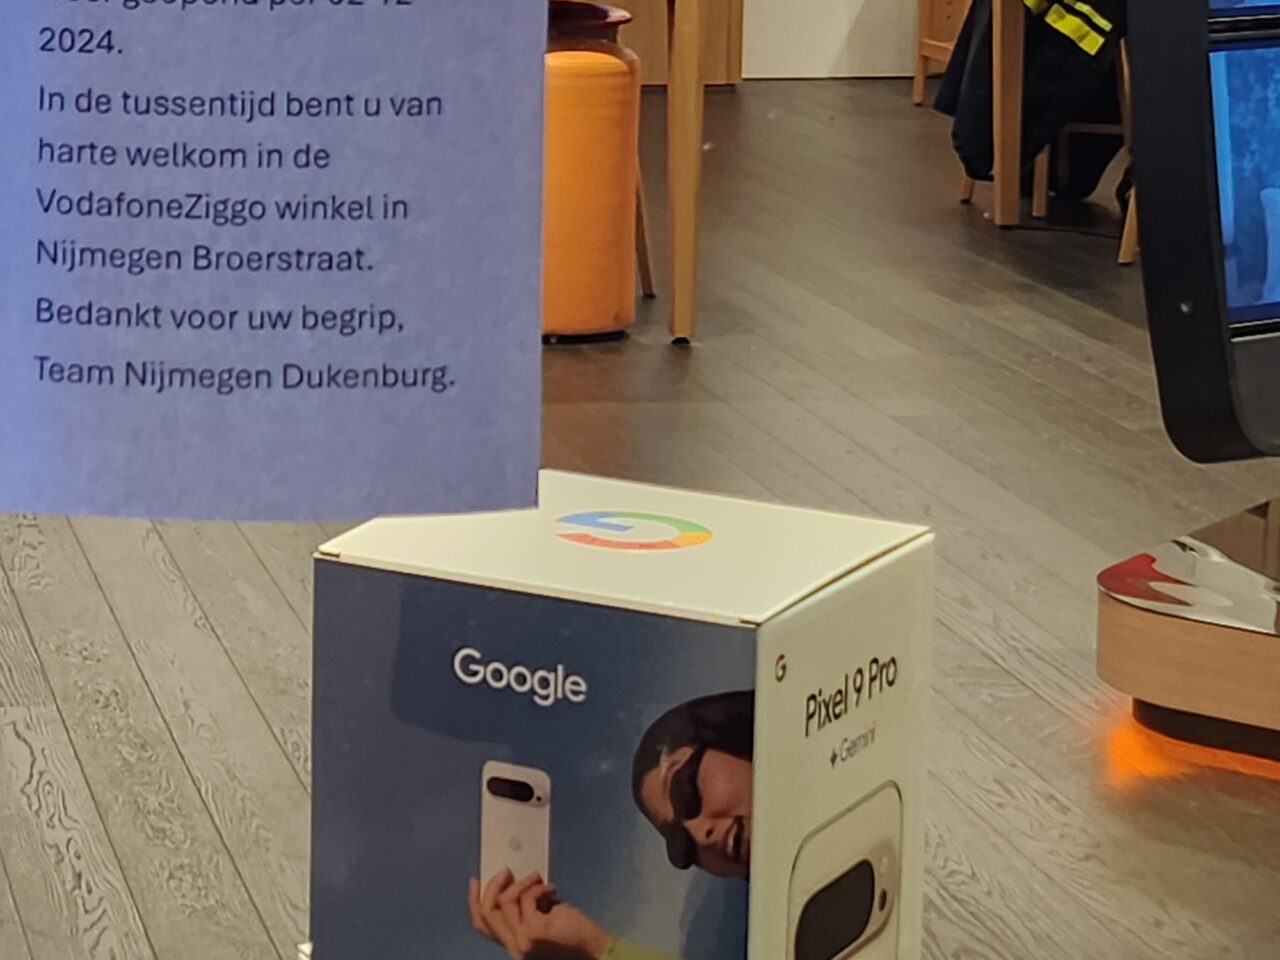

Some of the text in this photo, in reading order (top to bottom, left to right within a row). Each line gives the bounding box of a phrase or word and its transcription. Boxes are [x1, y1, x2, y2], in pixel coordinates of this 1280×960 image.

[39, 27, 123, 54] 2024.
[39, 85, 442, 123] In de tussentijd bent u van
[38, 137, 331, 169] harte welkom in de
[36, 188, 408, 227] VodafoneZiggo winkel in
[37, 238, 374, 276] Nijmegen Broerstraat.
[36, 297, 404, 337] Bedankt voor uw begrip,
[34, 355, 455, 395] Team Nijmegen Dukenburg.
[453, 647, 588, 707] Google
[805, 656, 898, 738] Pixel 9 Pro
[840, 721, 877, 762] Gemini
